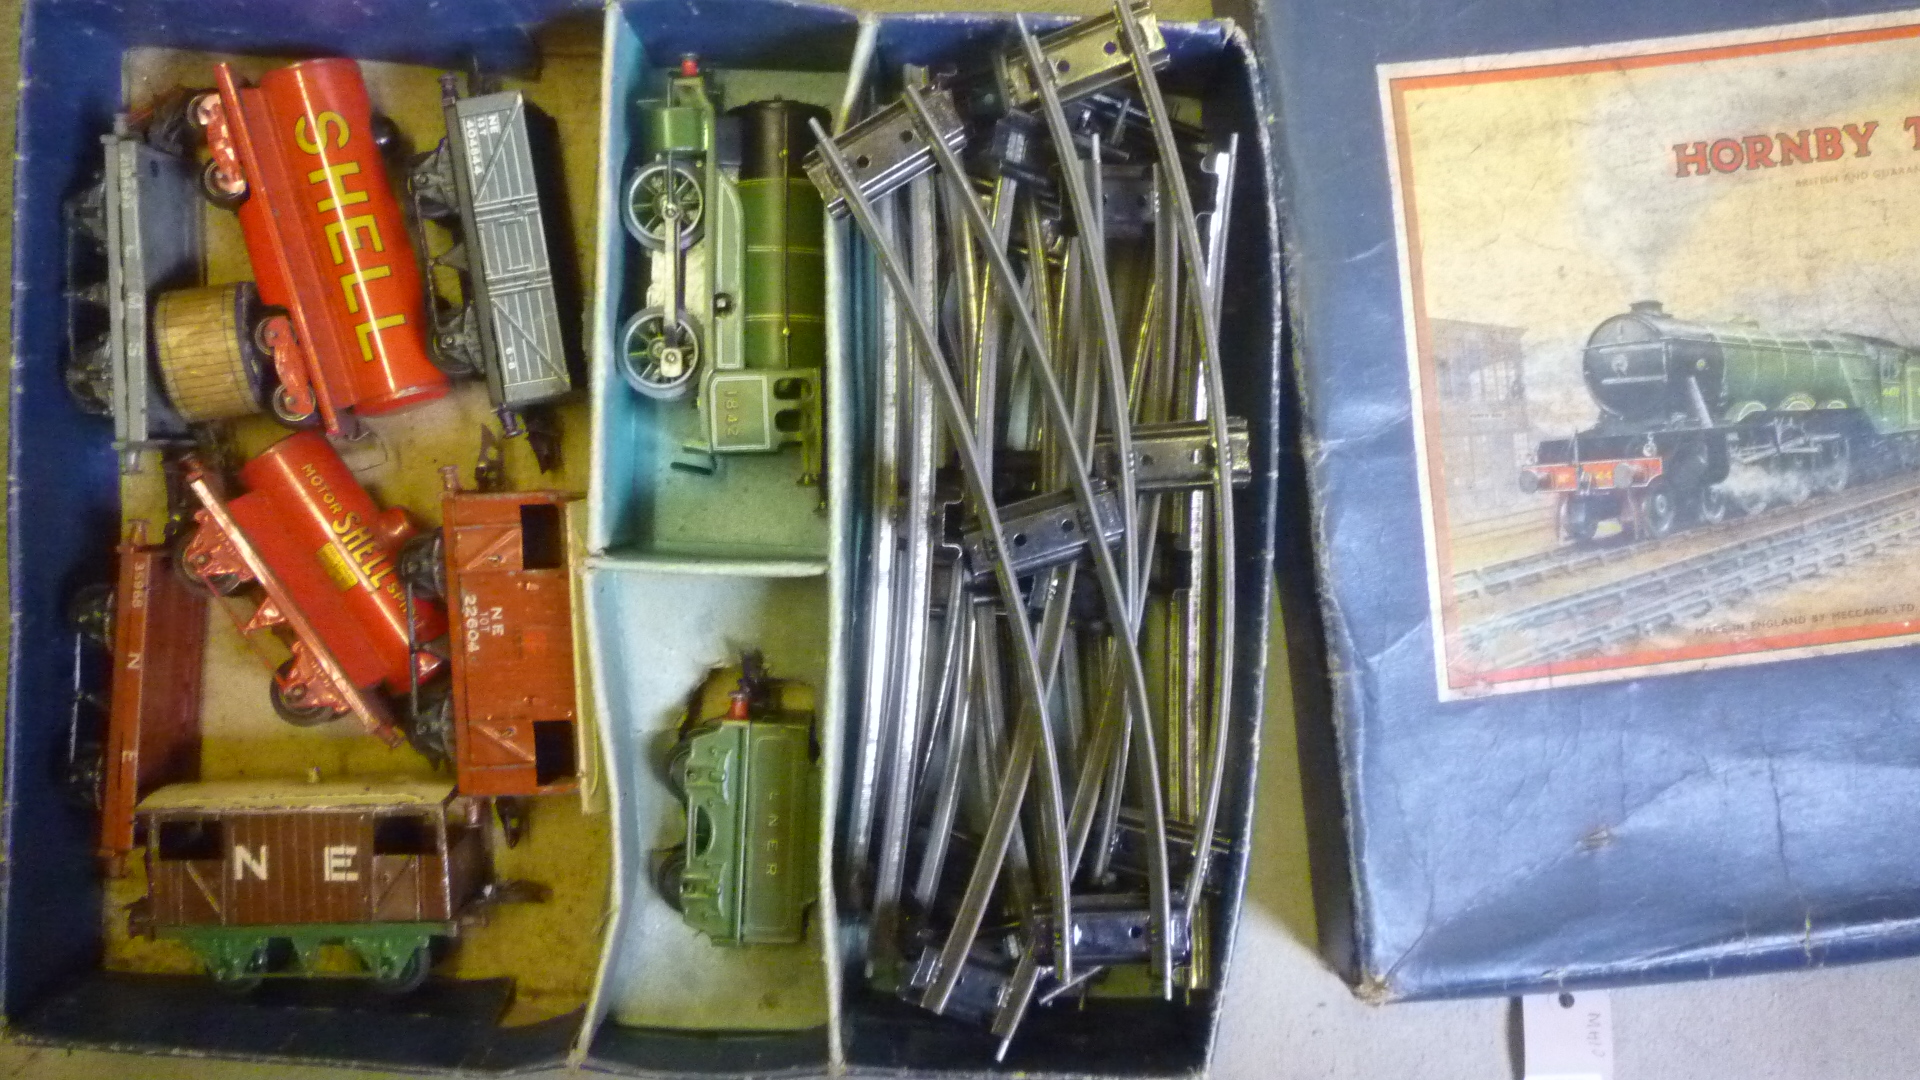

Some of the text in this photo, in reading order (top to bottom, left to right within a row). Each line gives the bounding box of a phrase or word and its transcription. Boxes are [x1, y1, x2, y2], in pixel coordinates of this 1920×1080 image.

[487, 112, 501, 134] NE
[1672, 121, 1879, 178] HORNBY
[1843, 170, 1868, 184] AND
[294, 111, 407, 362] SHELL
[302, 463, 343, 515] MOTOR
[332, 511, 394, 589] SHELL
[464, 594, 480, 652] 22604
[1750, 615, 1806, 630] ENGLAND
[1812, 613, 1825, 624] BY
[1832, 606, 1888, 621] MECCANO
